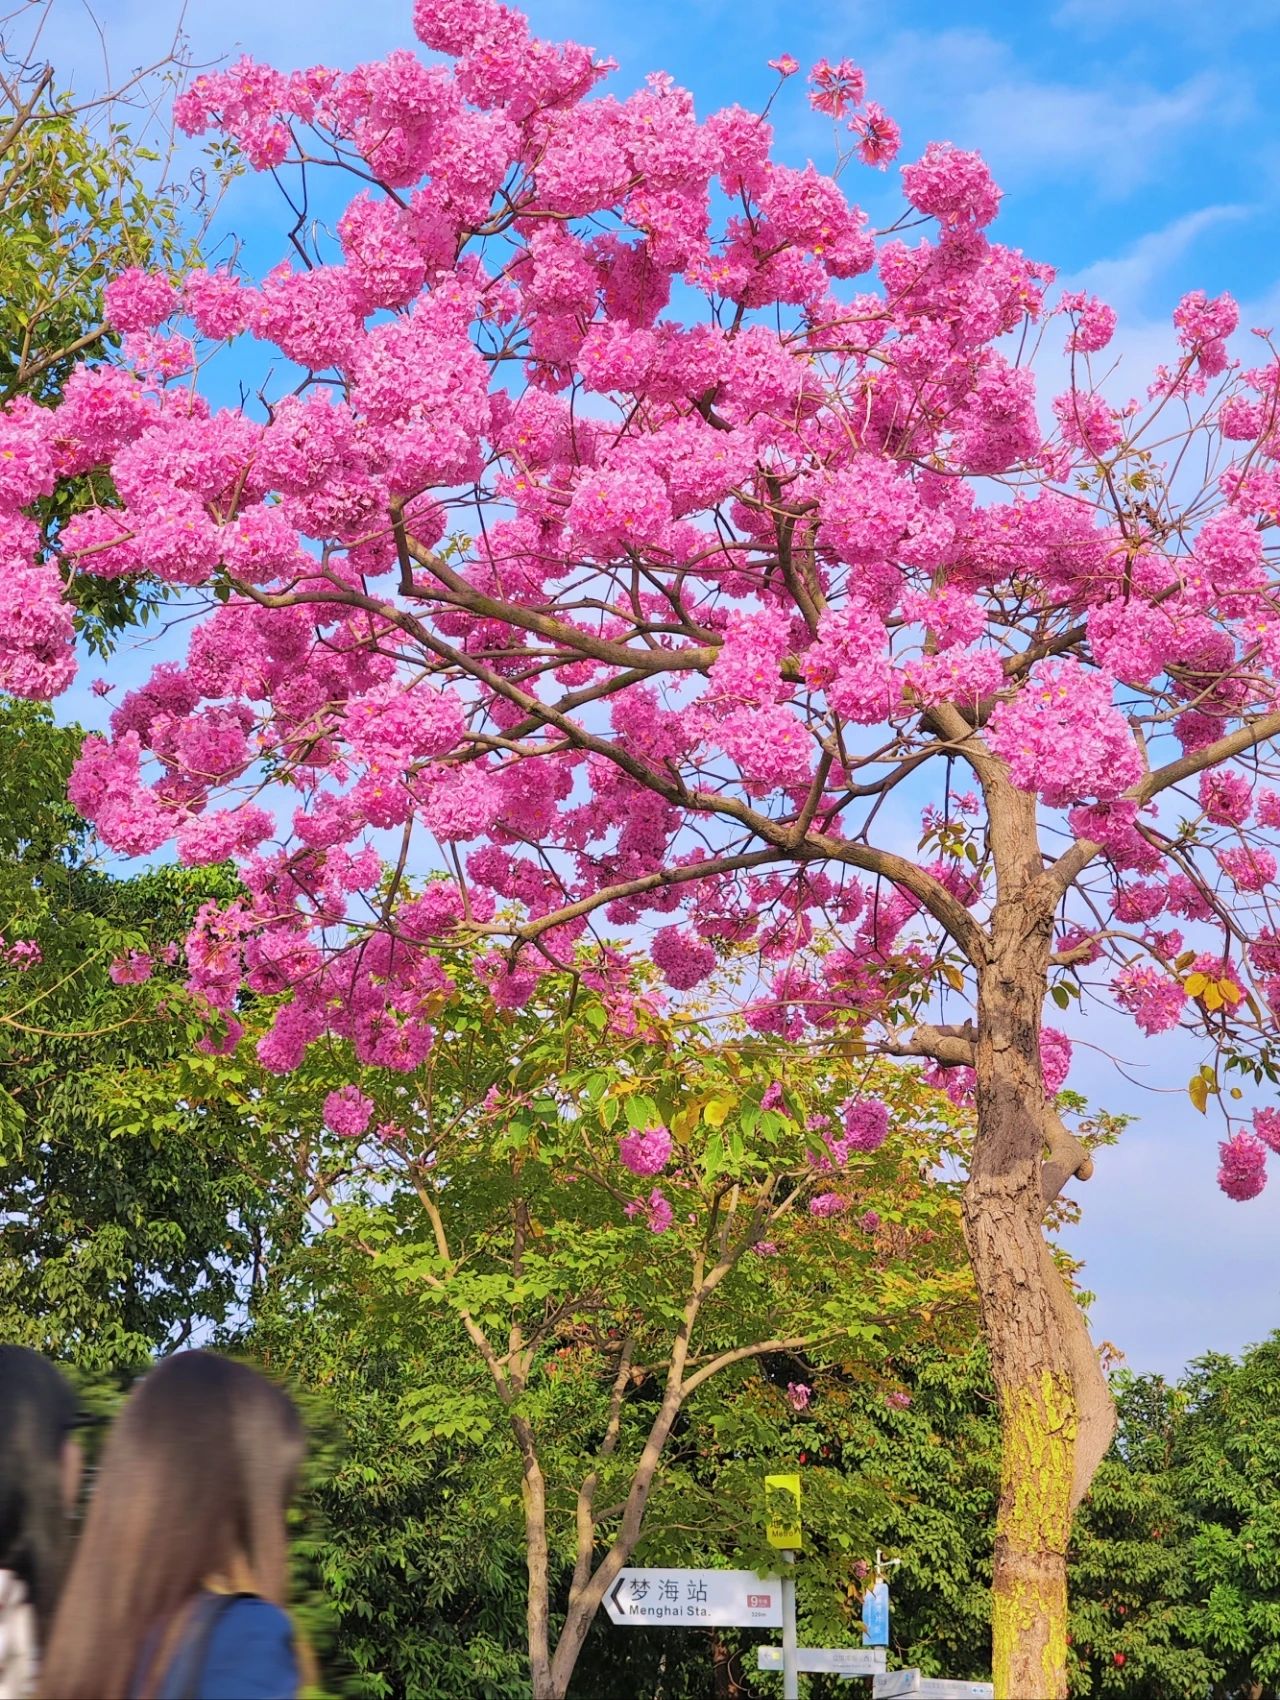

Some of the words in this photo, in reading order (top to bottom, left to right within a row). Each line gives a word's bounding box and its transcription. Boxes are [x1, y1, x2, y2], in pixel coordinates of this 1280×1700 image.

[771, 1530, 794, 1538] Metro
[630, 1578, 708, 1602] 梦海站
[750, 1596, 758, 1607] 9
[629, 1605, 683, 1618] Menghai
[687, 1606, 711, 1617] Sta.
